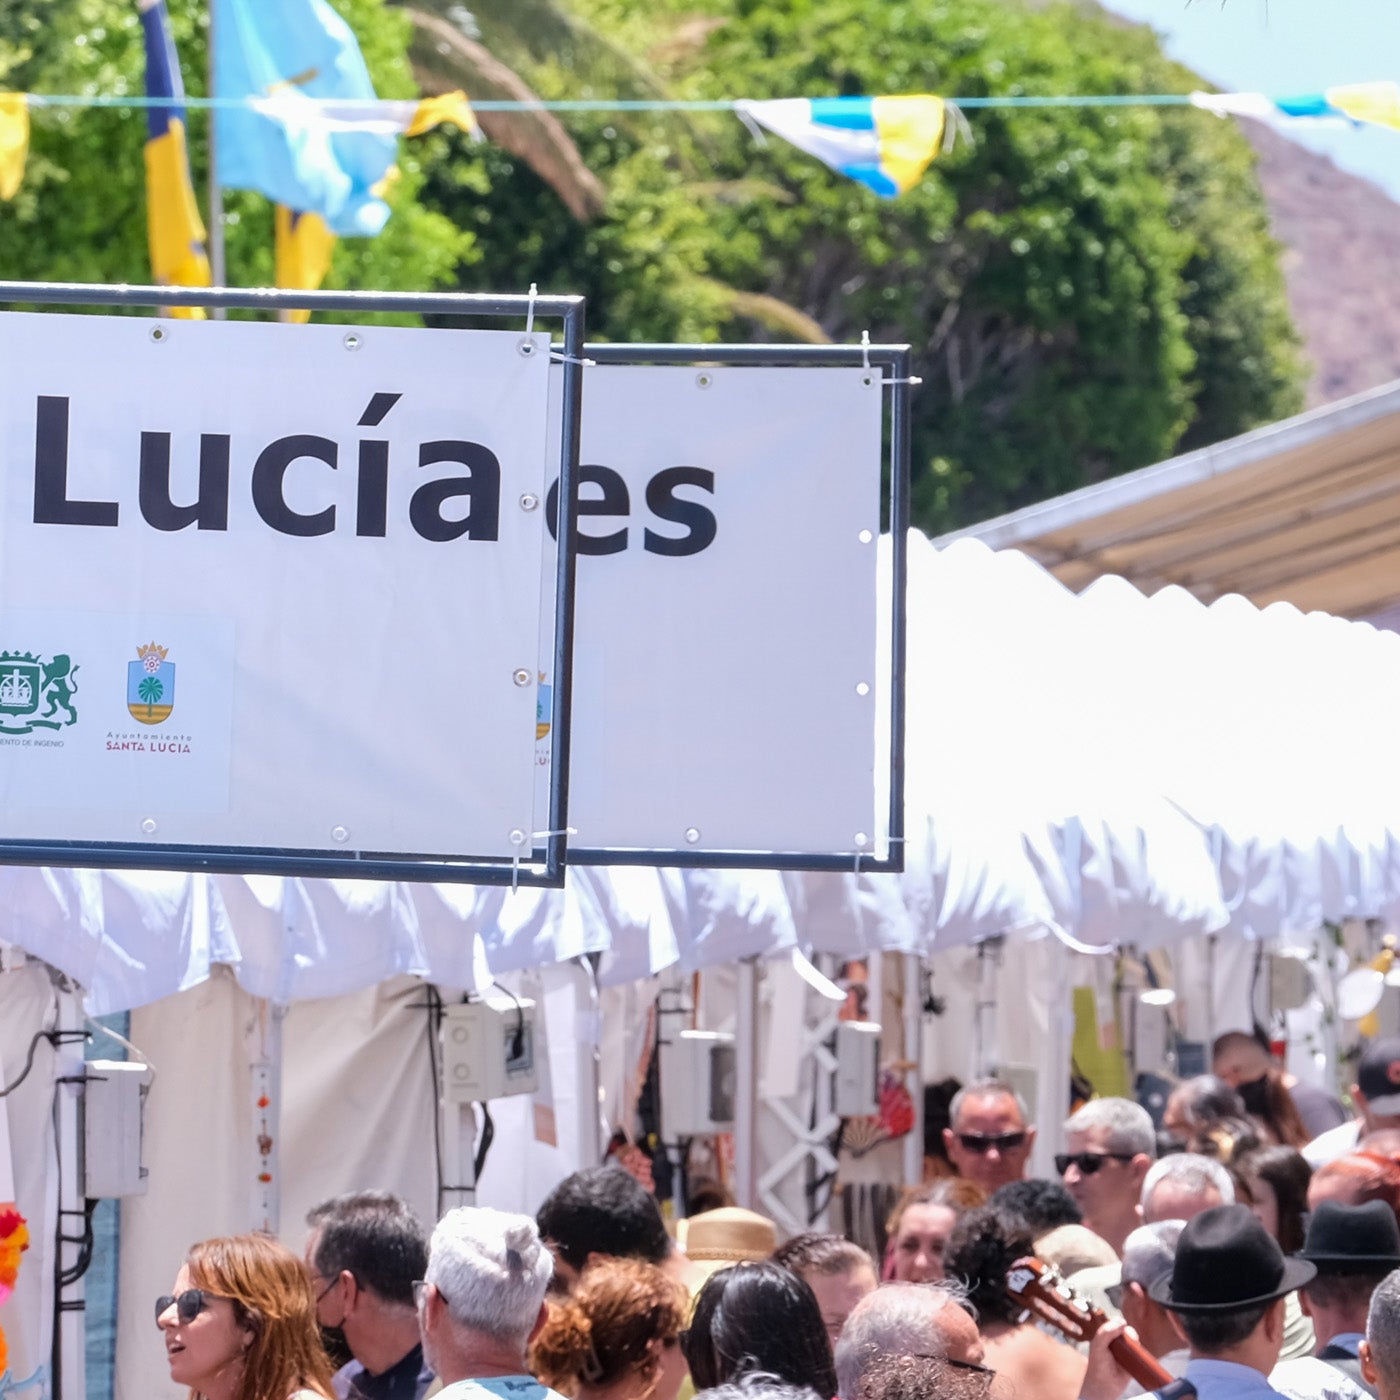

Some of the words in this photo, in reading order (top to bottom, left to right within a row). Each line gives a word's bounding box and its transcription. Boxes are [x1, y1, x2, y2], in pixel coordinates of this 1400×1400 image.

[34, 392, 501, 543] Lucía
[546, 464, 717, 557] es
[107, 732, 192, 741] Ayuntamiento
[34, 739, 64, 747] INGENIO
[106, 741, 145, 751] SANTA
[150, 743, 191, 753] LUCIA
